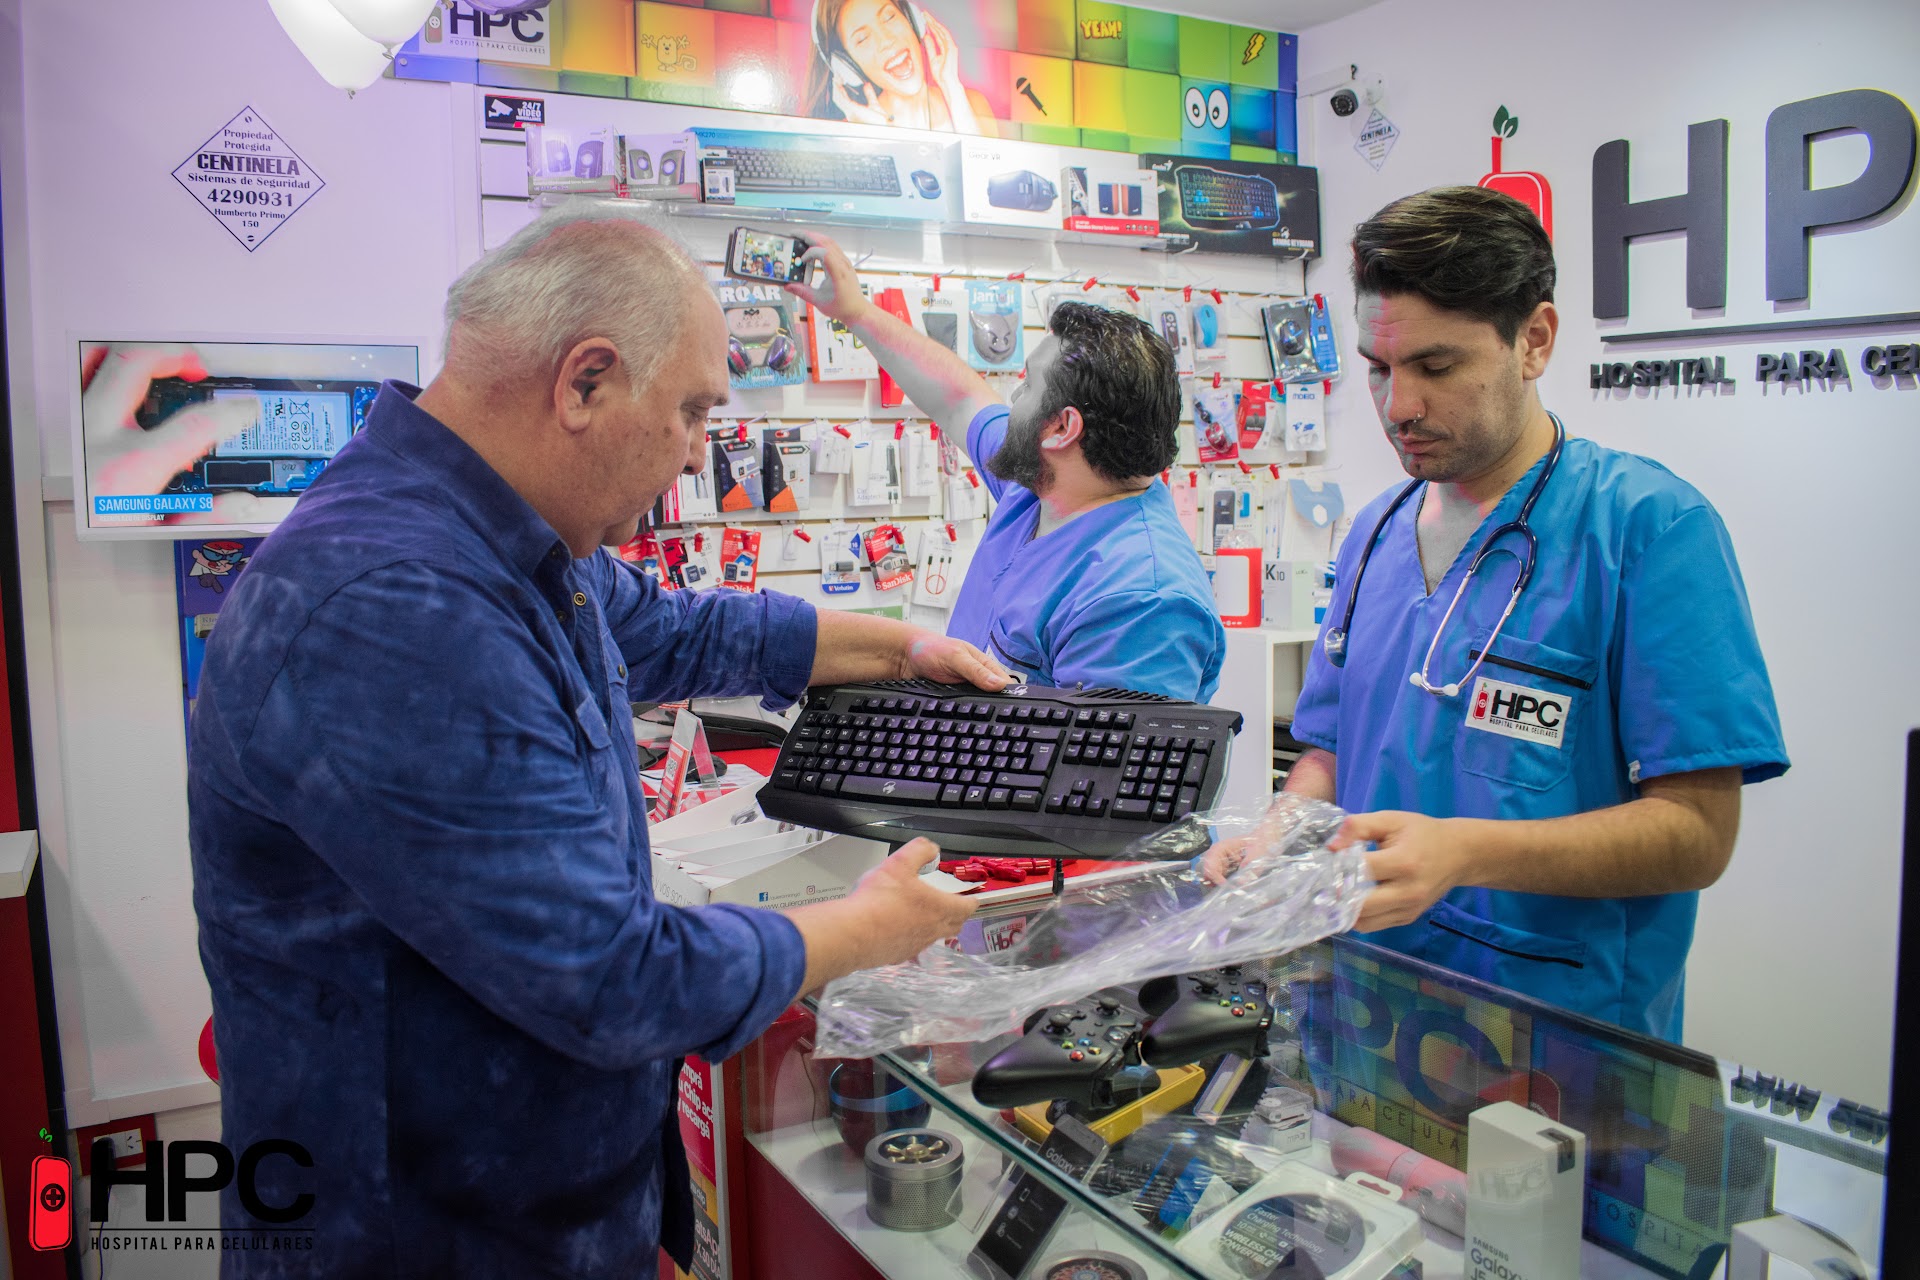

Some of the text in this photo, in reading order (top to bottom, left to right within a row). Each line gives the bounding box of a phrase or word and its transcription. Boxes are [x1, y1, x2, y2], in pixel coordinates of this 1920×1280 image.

[450, 0, 544, 43] HPC
[1080, 19, 1122, 40] YEAH!
[450, 39, 483, 48] HOSPITAL
[507, 45, 545, 54] CELULARES
[517, 108, 541, 117] VIDEO
[522, 101, 541, 110] 24/7
[224, 129, 273, 140] Propiedad
[224, 141, 271, 152] Protegida
[197, 153, 300, 176] CENTINELA
[188, 173, 310, 189] Sistemas de Seguridad
[207, 188, 292, 207] 4290931
[214, 208, 286, 219] Humberto Primo
[242, 220, 259, 228] 150
[719, 285, 781, 303] ROAR
[1590, 356, 1736, 389] HOSPITAL
[1755, 349, 1850, 382] PARA
[99, 496, 213, 512] SAMGUNG GALAXY S8
[882, 573, 912, 590] SanDisk
[1265, 563, 1285, 581] K10
[1491, 690, 1562, 728] HPC
[1489, 719, 1558, 739] HOSPITAL PARA CELULARES
[684, 1081, 701, 1111] Chip
[1323, 1077, 1370, 1112] PARA
[681, 1100, 710, 1140] recargá
[1045, 1147, 1076, 1175] Galaxy
[1254, 1207, 1279, 1221] Faster
[1225, 1229, 1266, 1252] WIRELESS
[1247, 1212, 1326, 1254] Charging Technology
[1219, 1236, 1275, 1268] CONVERTIBLE
[1473, 1236, 1509, 1262] SAMSUNG
